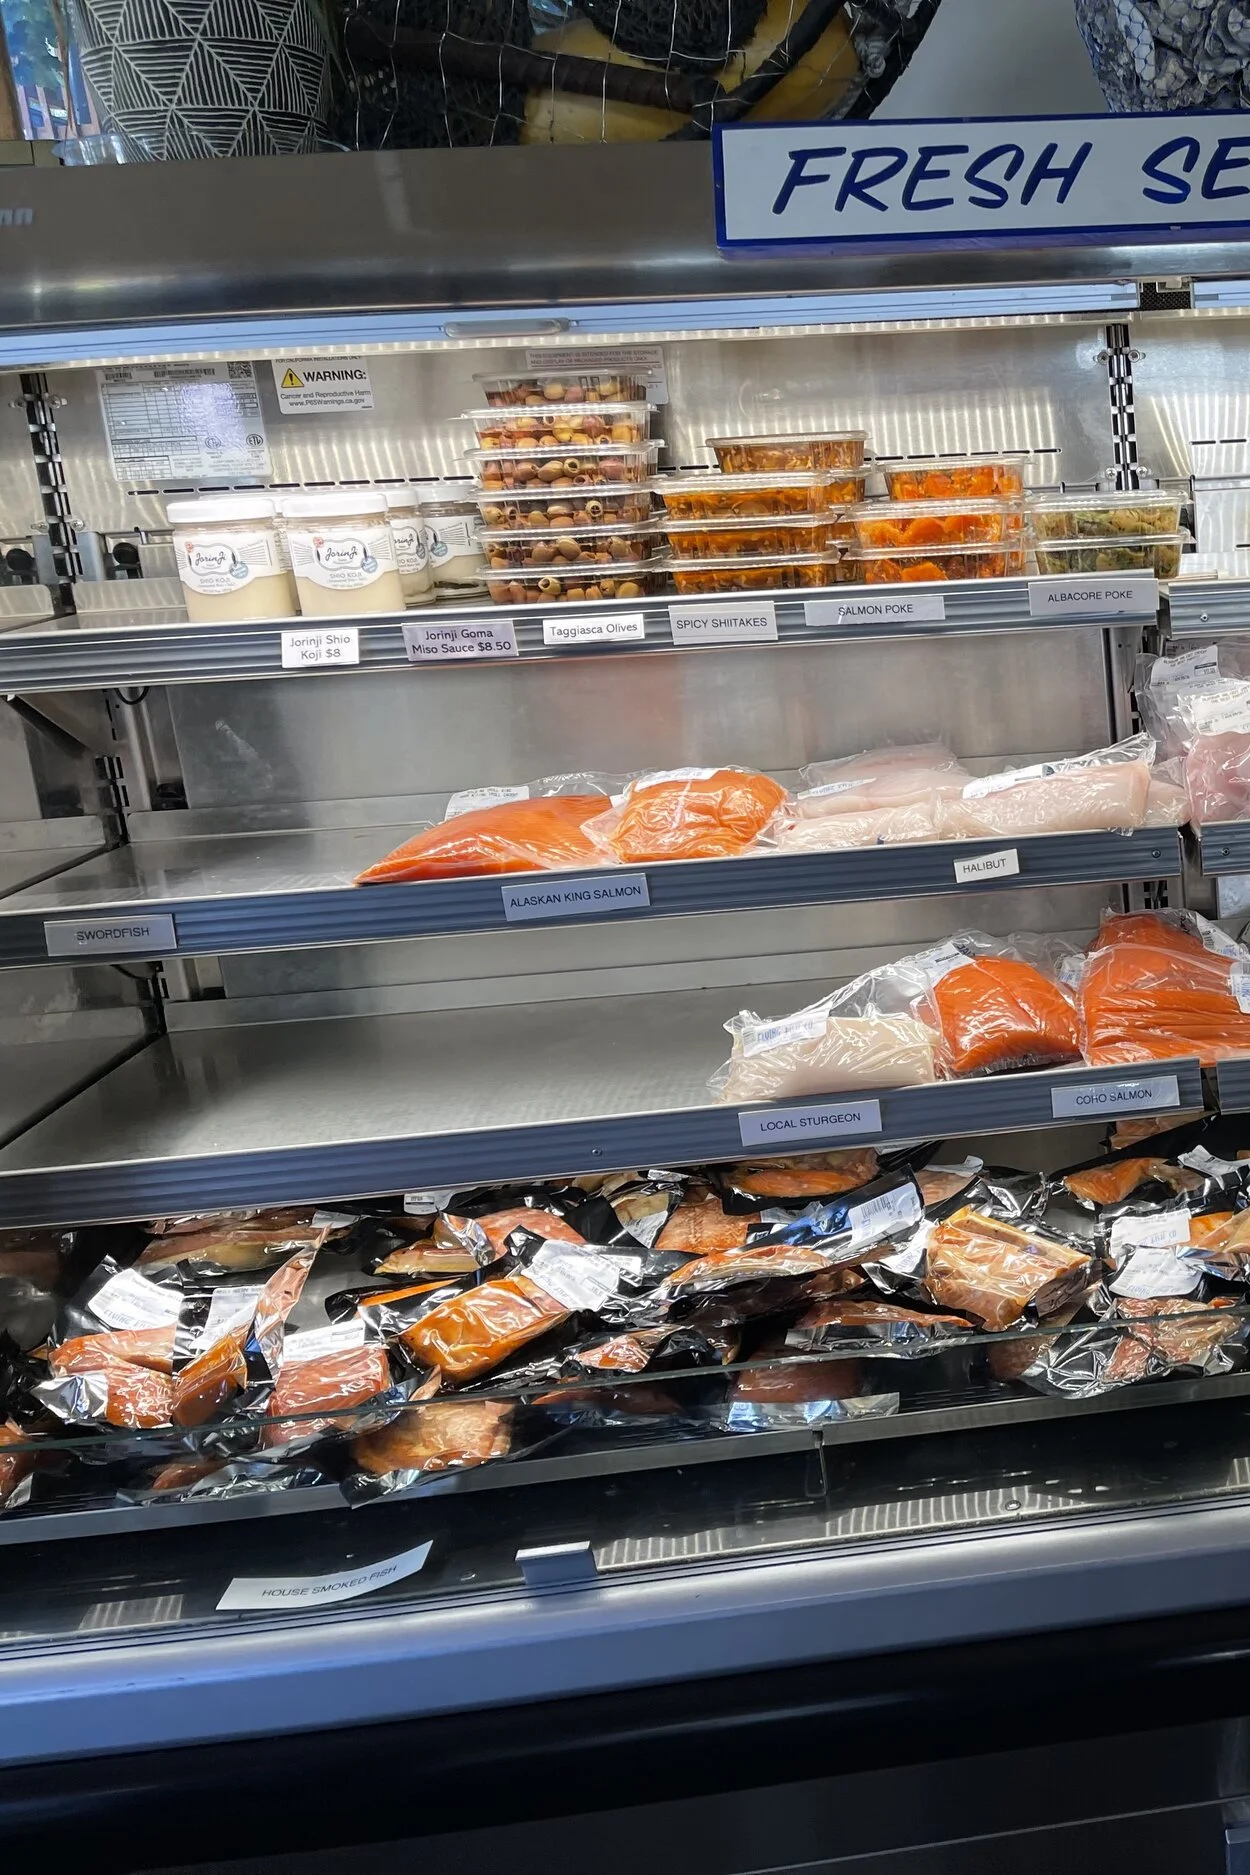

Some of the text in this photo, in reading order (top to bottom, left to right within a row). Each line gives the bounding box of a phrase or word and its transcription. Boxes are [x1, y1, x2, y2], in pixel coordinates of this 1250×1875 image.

[772, 142, 1092, 215] FRESH
[303, 369, 367, 382] WARNING:
[315, 390, 354, 399] Reproductive
[1047, 589, 1133, 602] ALBACORE POKE
[838, 603, 914, 617] SALMON POKE
[549, 621, 638, 638] Taggiasca Olives
[676, 616, 767, 629] SPICY SHIITAKES
[290, 634, 351, 650] Jorinji Shio
[425, 628, 494, 642] Jorinji Goma
[301, 648, 341, 661] Koji $8
[412, 641, 511, 655] Miso Sauce $8.50
[963, 858, 1006, 873] HALIBUT
[510, 886, 641, 908] ALASKAN KING SALMON
[76, 927, 149, 941] SWORDFISH
[1076, 1088, 1152, 1105] COHO SALMON
[760, 1113, 861, 1132] LOCAL STURGEON
[262, 1565, 397, 1597] HOUSE SMOKED FISH
